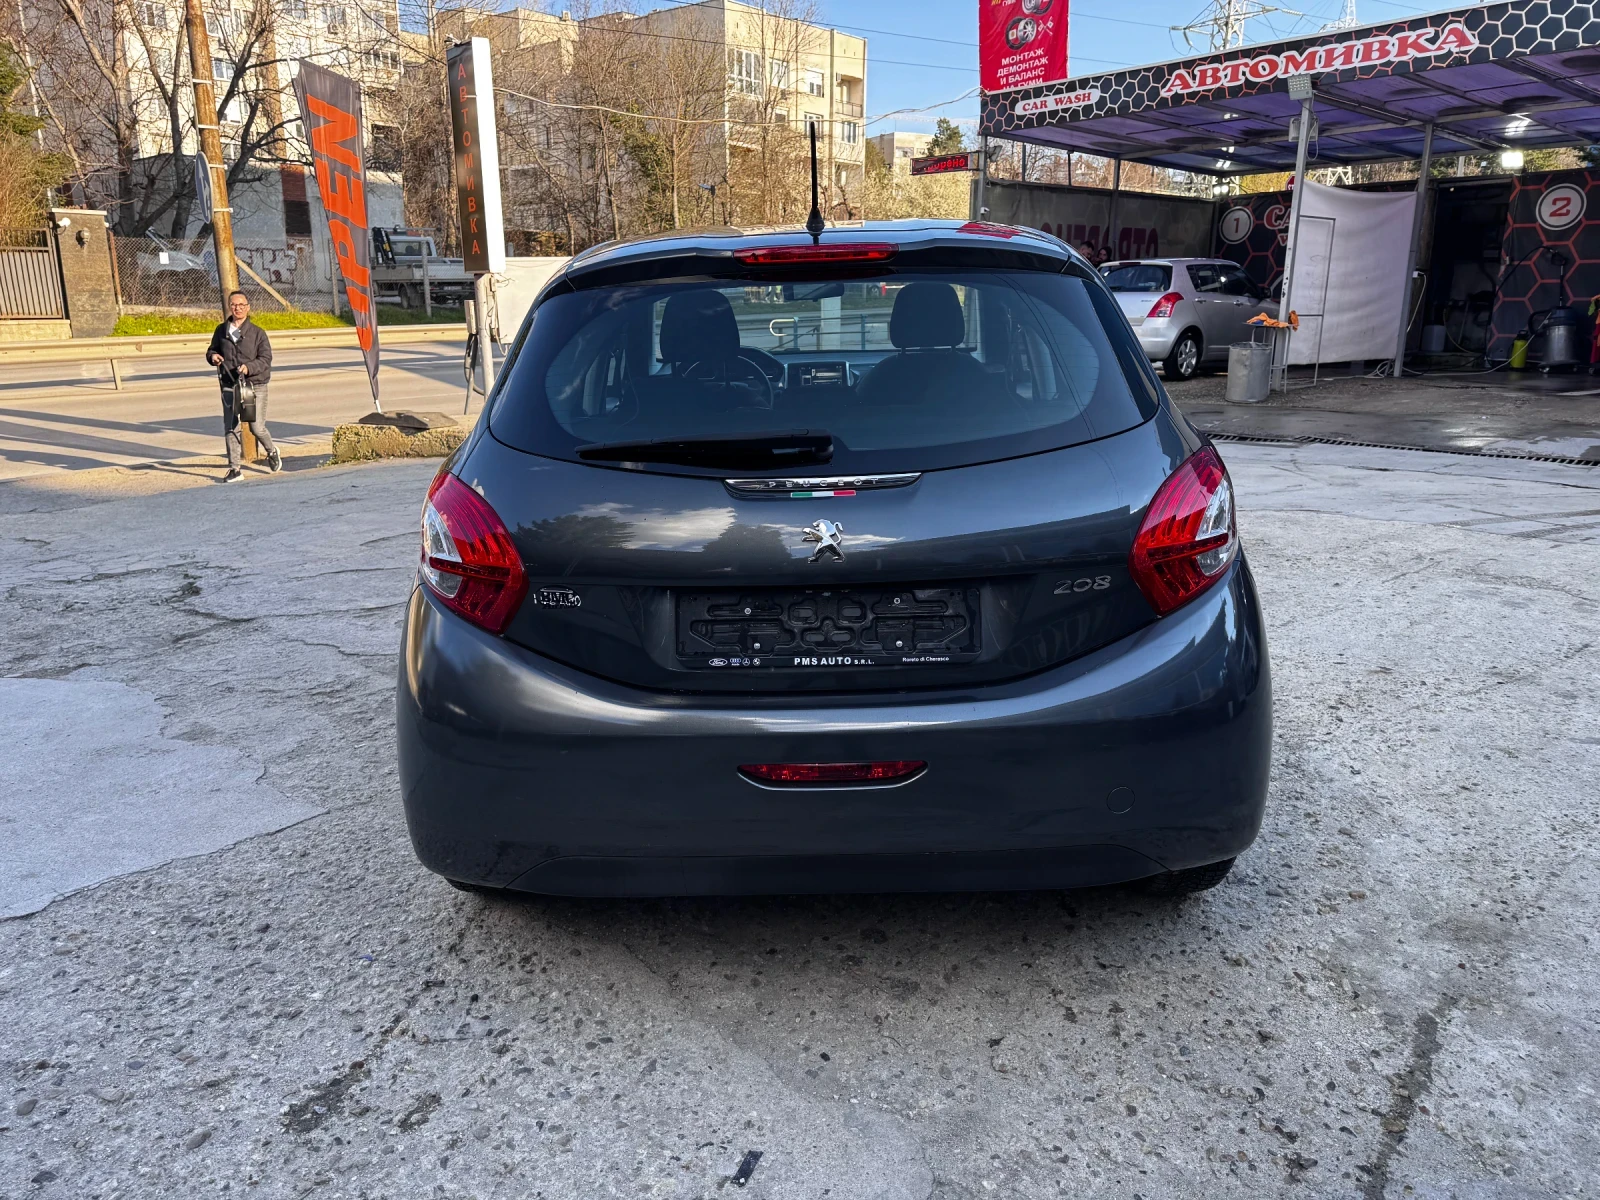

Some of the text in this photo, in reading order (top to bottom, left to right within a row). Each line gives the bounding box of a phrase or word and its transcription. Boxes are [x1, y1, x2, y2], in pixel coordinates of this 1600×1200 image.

[1001, 47, 1045, 66] МОНТАЖ
[1163, 24, 1478, 95] АВТОМИВКА
[996, 56, 1049, 78] ДЕМОНТАЖ
[1000, 67, 1045, 85] И БАЛАНС
[1022, 91, 1092, 112] CAR WASH
[457, 63, 480, 255] АВТОМИВКА
[1549, 197, 1571, 217] 2
[1233, 217, 1240, 234] 1
[1264, 205, 1291, 230] CA
[1053, 575, 1112, 594] 208
[794, 657, 818, 665] PMS
[820, 657, 851, 665] AUTO
